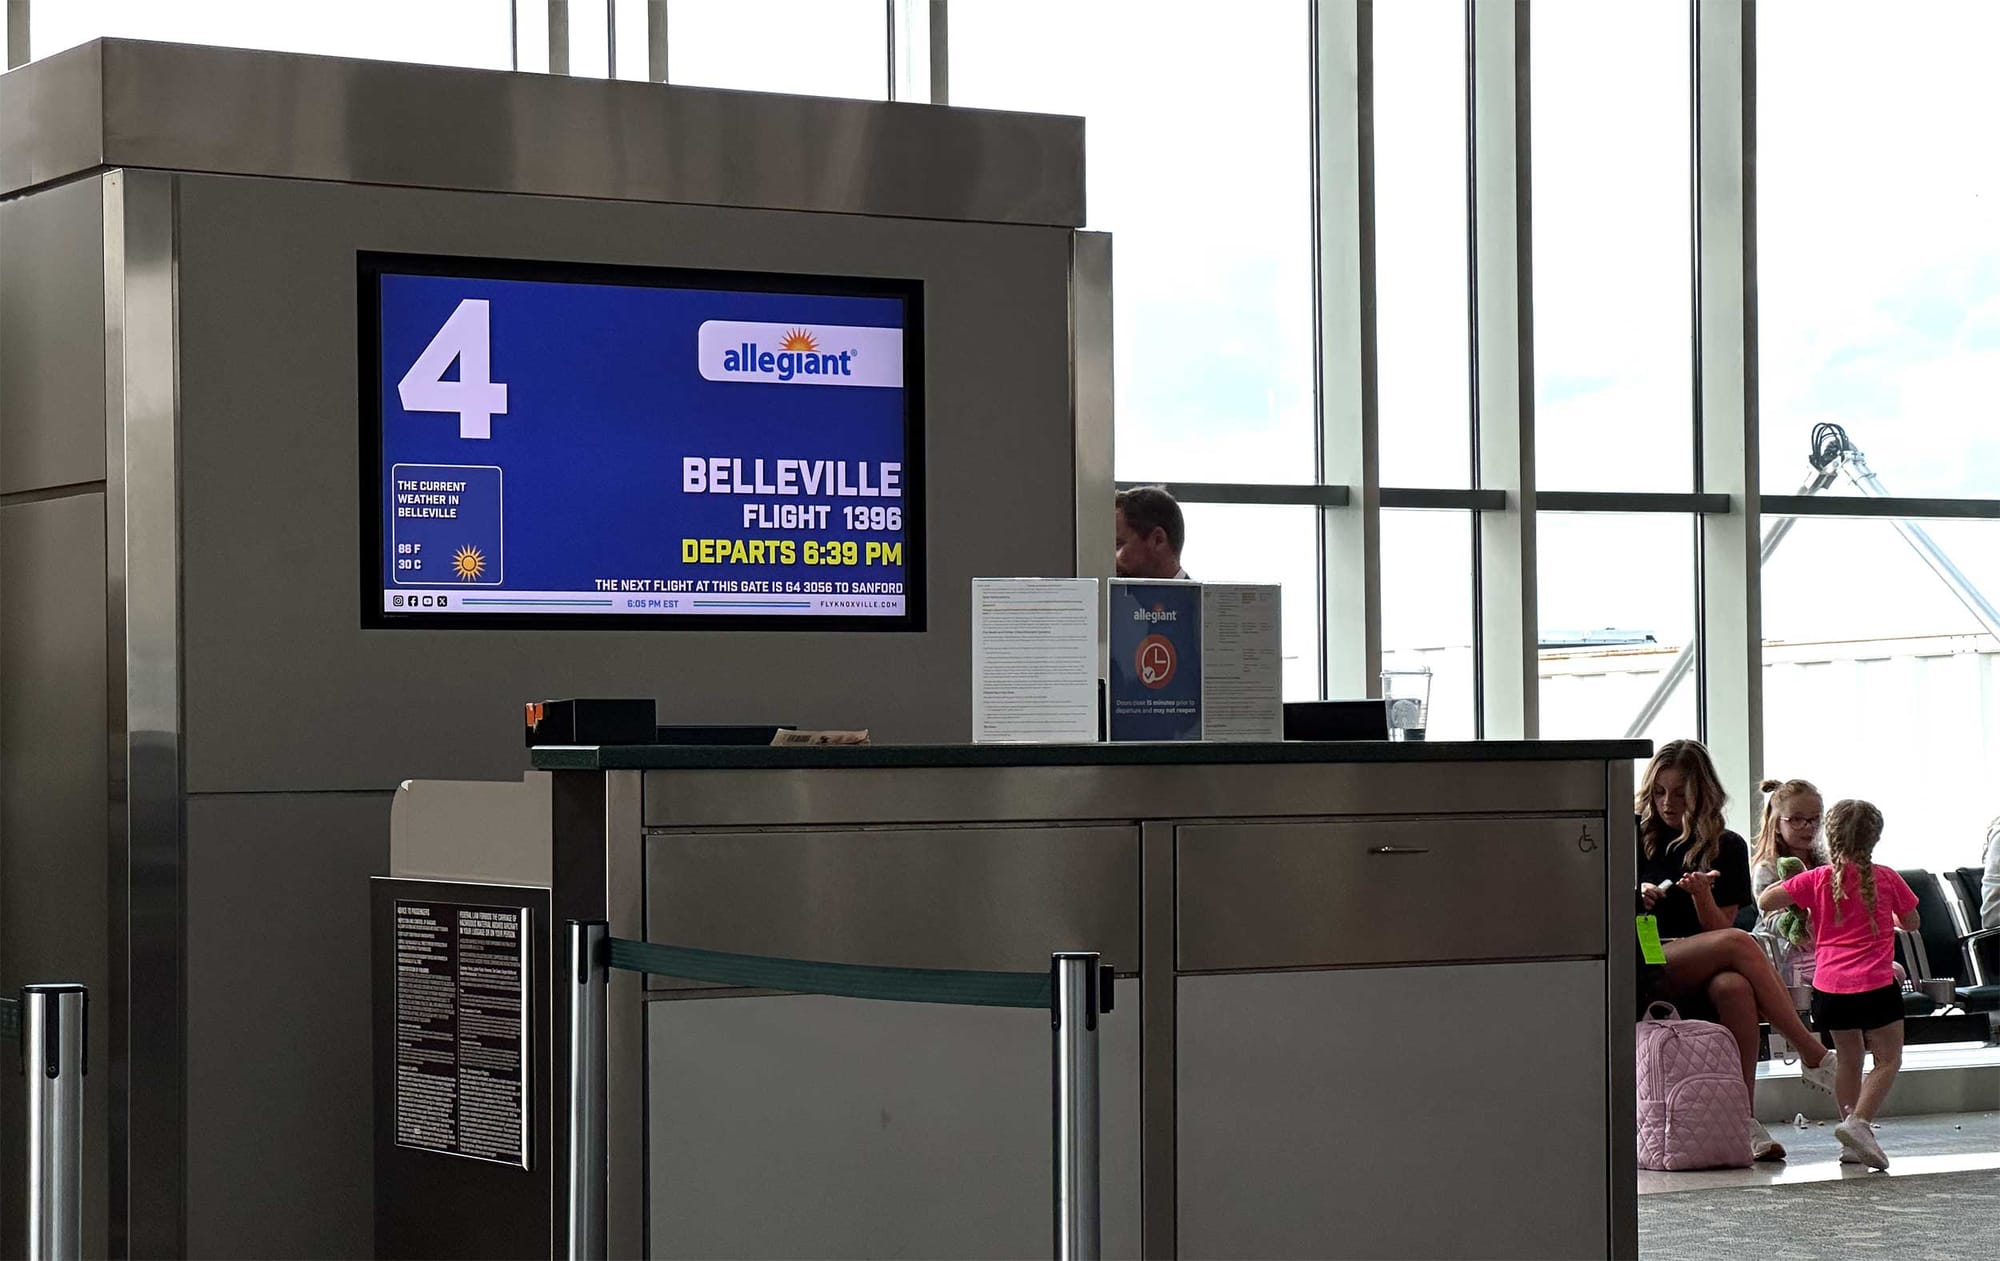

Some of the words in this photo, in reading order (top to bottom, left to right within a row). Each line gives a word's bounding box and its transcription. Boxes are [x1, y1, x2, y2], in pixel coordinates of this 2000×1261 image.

[398, 299, 508, 439] 4
[724, 343, 851, 381] allegiant
[683, 457, 901, 497] BELLEVILLE
[398, 481, 418, 491] THE
[420, 481, 466, 492] CURRENT
[398, 494, 446, 505] WEATHER
[449, 495, 459, 505] IN
[398, 507, 457, 518] BELLEVILLE
[743, 504, 831, 529] FLIGHT
[843, 506, 902, 531] 1396
[414, 544, 421, 554] F
[682, 539, 796, 564] DEPARTS
[803, 541, 858, 566] 6:39
[865, 541, 902, 566] PM
[398, 560, 412, 570] 30
[414, 560, 422, 570] C
[595, 579, 618, 591] THE
[621, 580, 651, 591] NEXT
[654, 580, 693, 591] FLIGHT
[695, 580, 710, 592] AT
[712, 581, 738, 592] THIS
[740, 581, 769, 592] GATE
[772, 581, 783, 592] IS
[785, 581, 801, 593] G4
[803, 582, 833, 593] 3056
[835, 582, 849, 593] TO
[851, 582, 903, 594] SANFORD
[627, 600, 646, 608] 6:05
[648, 600, 661, 608] PM
[663, 600, 679, 608] EST
[1133, 608, 1177, 624] allegiant
